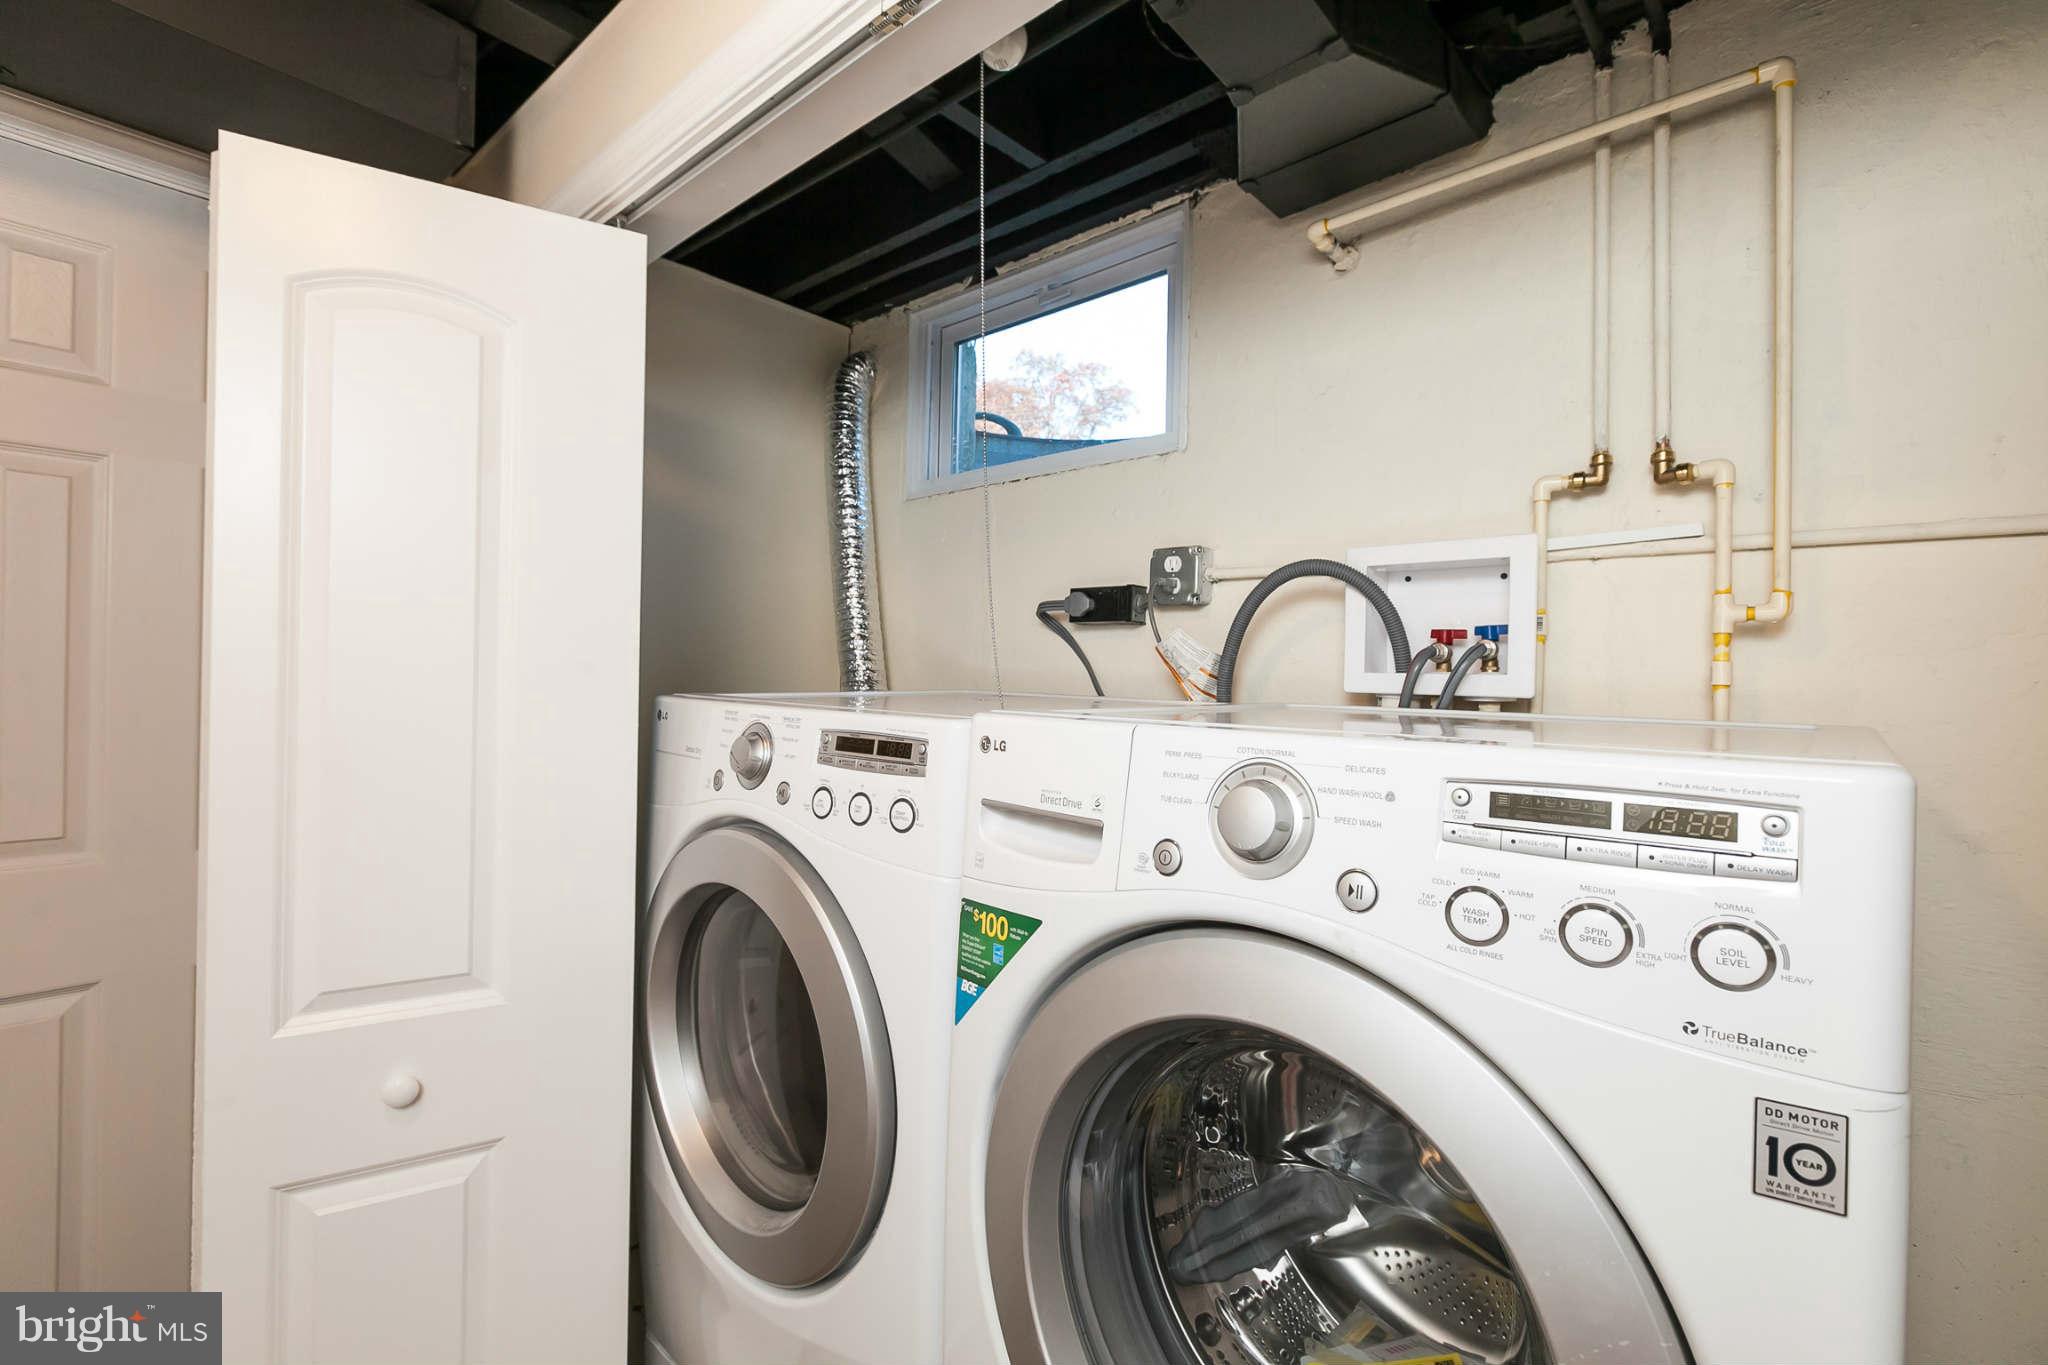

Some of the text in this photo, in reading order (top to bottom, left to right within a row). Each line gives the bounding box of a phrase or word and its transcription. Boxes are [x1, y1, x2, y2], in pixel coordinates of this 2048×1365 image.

[1345, 764, 1386, 776] DELICATES
[1318, 787, 1337, 795] HAND
[1334, 816, 1382, 829] SPEED WASH
[1584, 846, 1633, 859] EXTRA RINSE
[1460, 867, 1501, 879] ECO WARM
[1736, 864, 1793, 877] DELAY WASH
[1432, 878, 1452, 887] COLD
[1421, 892, 1435, 900] TAP
[1508, 889, 1534, 899] WARM
[1579, 884, 1616, 896] MEDIUM
[1418, 898, 1437, 907] COLD
[1714, 902, 1755, 914] NORMAL
[1462, 907, 1490, 918] WASH
[1519, 912, 1536, 921] HOT
[973, 908, 1009, 941] $100
[1544, 928, 1556, 936] NO
[1584, 926, 1608, 938] SPIN
[1539, 934, 1557, 943] SPIN
[1579, 933, 1613, 947] SPEED
[1446, 943, 1505, 961] ALL COLD RINSES
[1636, 951, 1662, 962] EXTRA
[1664, 954, 1687, 962] LIGHT
[1719, 947, 1747, 959] SOIL
[1636, 959, 1656, 968] HIGH
[1716, 956, 1751, 969] LEVEL
[1780, 974, 1814, 985] HEAVY
[961, 979, 978, 996] BGE
[1765, 1106, 1839, 1131] DD MOTOR
[1765, 1135, 1837, 1187] 10
[1795, 1158, 1823, 1172] YEAR
[1765, 1179, 1836, 1202] WARRANTY
